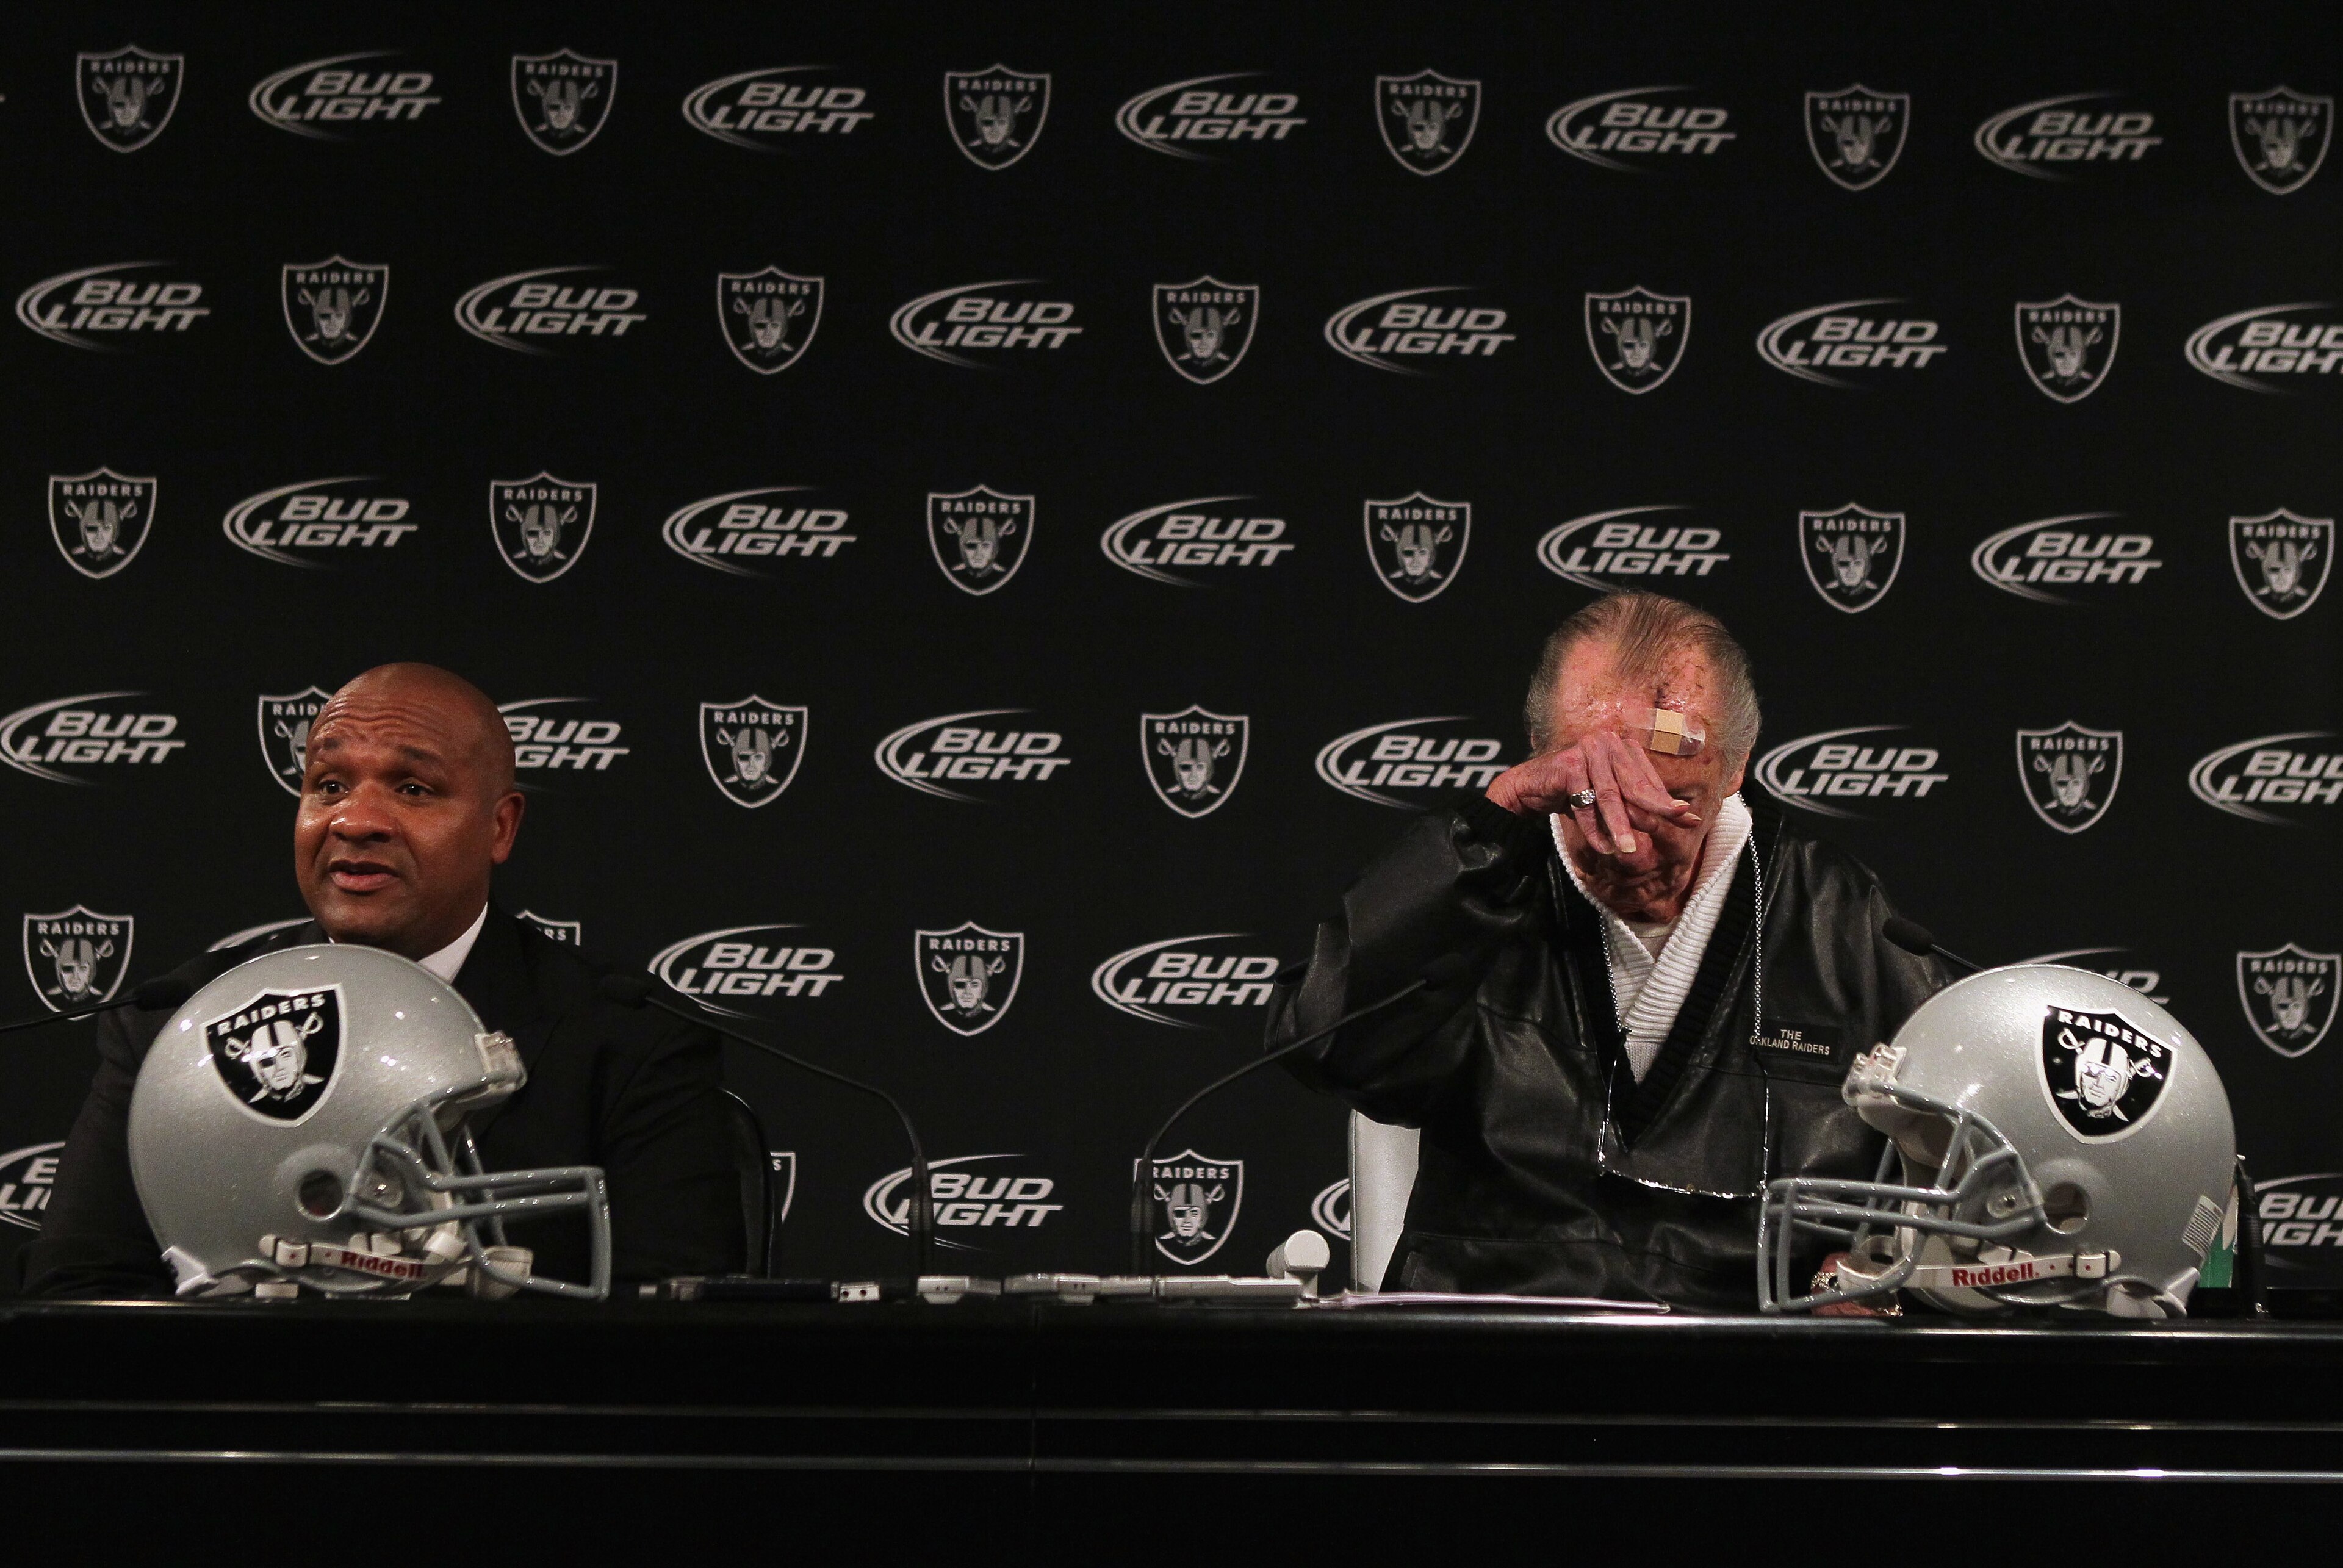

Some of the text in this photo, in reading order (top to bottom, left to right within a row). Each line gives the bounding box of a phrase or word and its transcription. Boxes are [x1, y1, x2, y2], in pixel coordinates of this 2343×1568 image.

[91, 60, 170, 73] RAIDERS
[525, 63, 604, 76] RAIDERS
[305, 70, 432, 96] BUD
[736, 82, 865, 108] BUD
[959, 78, 1037, 92] RAIDERS
[1390, 83, 1469, 96] RAIDERS
[278, 95, 441, 121] LIGHT
[1172, 90, 1298, 116] BUD
[1600, 103, 1727, 129] BUD
[1820, 99, 1896, 112] RAIDERS
[708, 107, 874, 135] LIGHT
[1144, 115, 1308, 142] LIGHT
[2029, 112, 2153, 137] BUD
[1573, 128, 1737, 154] LIGHT
[2003, 135, 2162, 161] LIGHT
[296, 271, 375, 284] RAIDERS
[732, 281, 811, 295] RAIDERS
[72, 279, 201, 306] BUD
[509, 284, 638, 310] BUD
[1168, 290, 1247, 304] RAIDERS
[43, 304, 210, 333] LIGHT
[945, 297, 1073, 323] BUD
[1378, 304, 1507, 330] BUD
[1600, 301, 1679, 314] RAIDERS
[2030, 309, 2109, 323] RAIDERS
[480, 309, 647, 337] LIGHT
[916, 322, 1082, 350] LIGHT
[1812, 317, 1938, 343] BUD
[1350, 329, 1516, 357] LIGHT
[1784, 342, 1948, 369] LIGHT
[2211, 345, 2343, 374] LIGH
[62, 483, 142, 497] RAIDERS
[503, 487, 583, 502] RAIDERS
[279, 495, 408, 522] BUD
[718, 505, 847, 531] BUD
[941, 500, 1021, 514] RAIDERS
[1380, 508, 1458, 522] RAIDERS
[251, 520, 417, 548] LIGHT
[1156, 514, 1285, 541] BUD
[1592, 523, 1721, 550] BUD
[1815, 519, 1893, 532] RAIDERS
[689, 530, 856, 558] LIGHT
[1128, 539, 1294, 567] LIGHT
[2026, 533, 2153, 558] BUD
[1563, 548, 1730, 577] LIGHT
[1999, 557, 2162, 584] LIGHT
[273, 703, 326, 716] RAID
[714, 711, 794, 725] RAIDERS
[46, 711, 175, 738] BUD
[503, 715, 621, 744] BUD
[1156, 721, 1235, 735] RAIDERS
[17, 736, 184, 764] LIGHT
[932, 728, 1060, 754] BUD
[1372, 735, 1500, 761] BUD
[2032, 737, 2111, 751] RAIDERS
[514, 744, 630, 770] GHT
[903, 753, 1070, 781] LIGHT
[1810, 745, 1938, 771] BUD
[1343, 760, 1510, 787] LIGHT
[1781, 770, 1948, 798] LIGHT
[2217, 775, 2343, 804] LIGH
[38, 922, 118, 936] RAIDERS
[704, 944, 832, 970] BUD
[930, 938, 1010, 952] RAIDERS
[1149, 953, 1278, 979] BUD
[675, 969, 841, 997] LIGHT
[217, 994, 325, 1036] RAIDERS
[1780, 1029, 1802, 1040] THE
[2058, 1010, 2162, 1057] RAIDERS
[1792, 1041, 1830, 1055] RAIDERS
[930, 1173, 1054, 1200] BUD
[2259, 1192, 2343, 1220] BU
[342, 1251, 423, 1278] Riddell
[1952, 1262, 2033, 1287] Riddell
